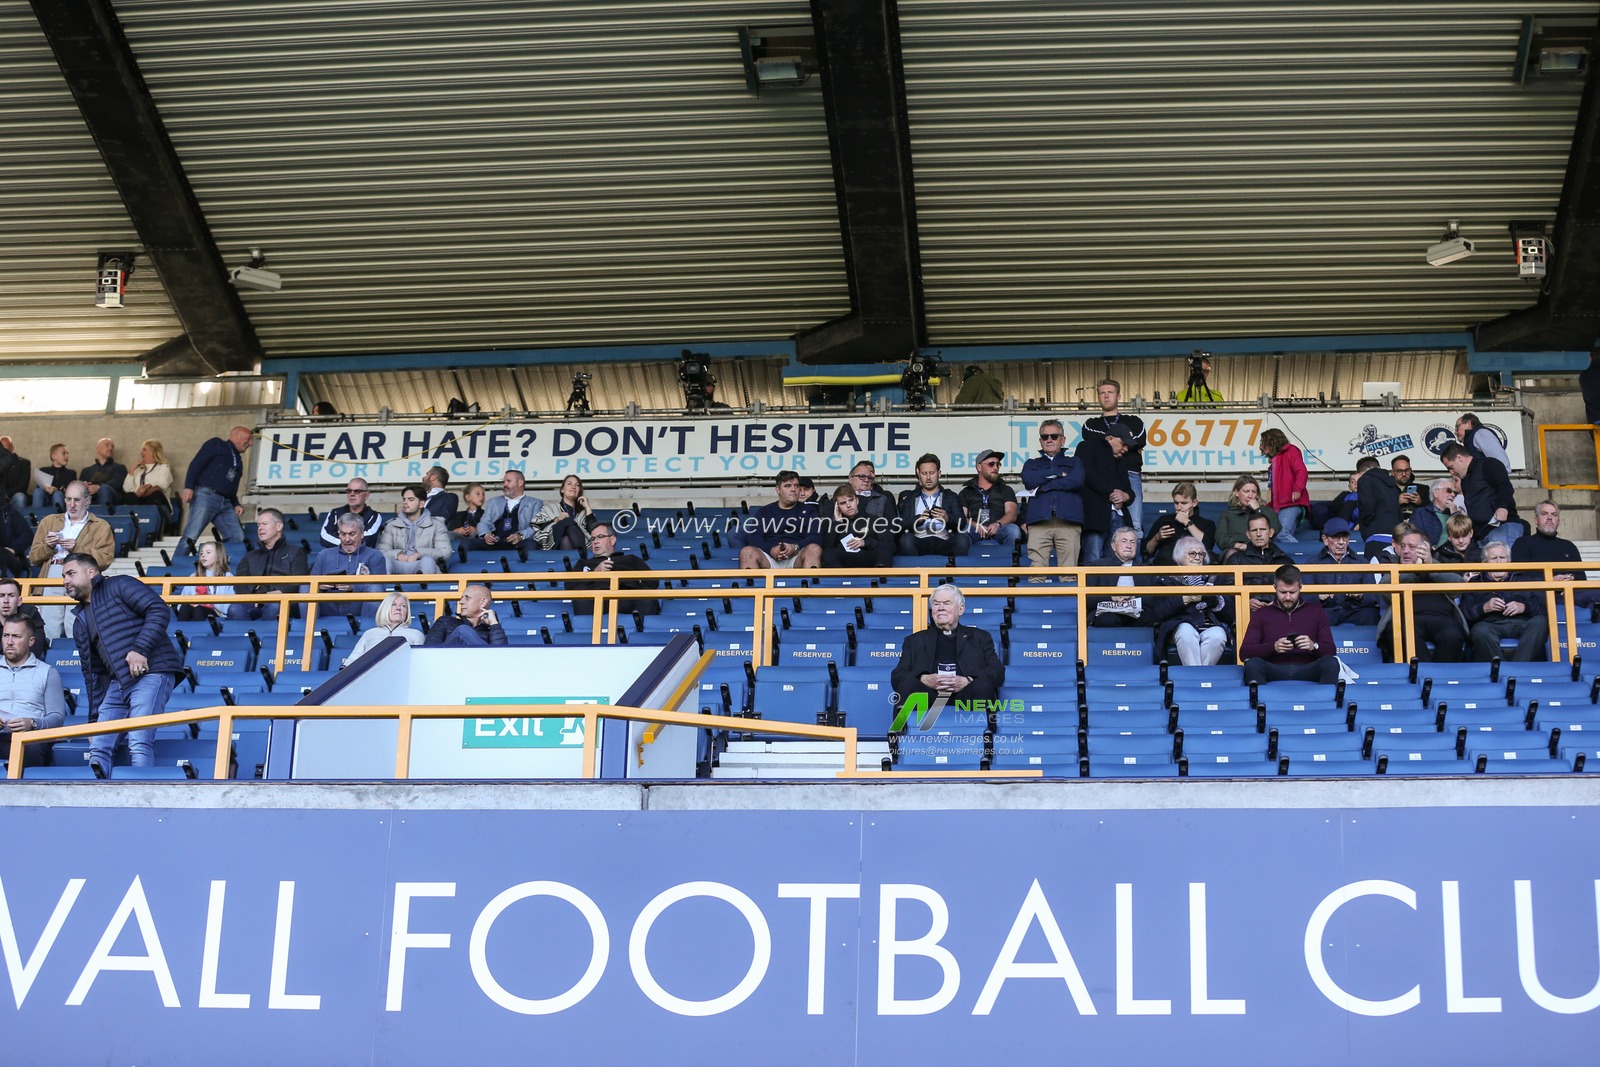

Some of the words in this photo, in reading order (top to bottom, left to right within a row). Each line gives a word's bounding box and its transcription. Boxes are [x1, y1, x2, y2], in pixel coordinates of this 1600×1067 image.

[269, 430, 388, 462] HEAR
[401, 428, 538, 460] HATE?
[552, 425, 696, 458] DON'T
[709, 422, 911, 454] HESITATE
[1147, 418, 1263, 447] 66777
[1366, 434, 1411, 452] MILLWALL
[1368, 446, 1391, 457] FOR
[1393, 441, 1413, 452] ALL
[268, 461, 389, 479] REPORT
[555, 455, 704, 475] PROTECT
[719, 452, 807, 471] YOUR
[950, 452, 1026, 469] BEIN
[1162, 449, 1236, 466] WITH
[792, 651, 832, 659] RESERVED
[385, 877, 1247, 1017] FOOTBALL
